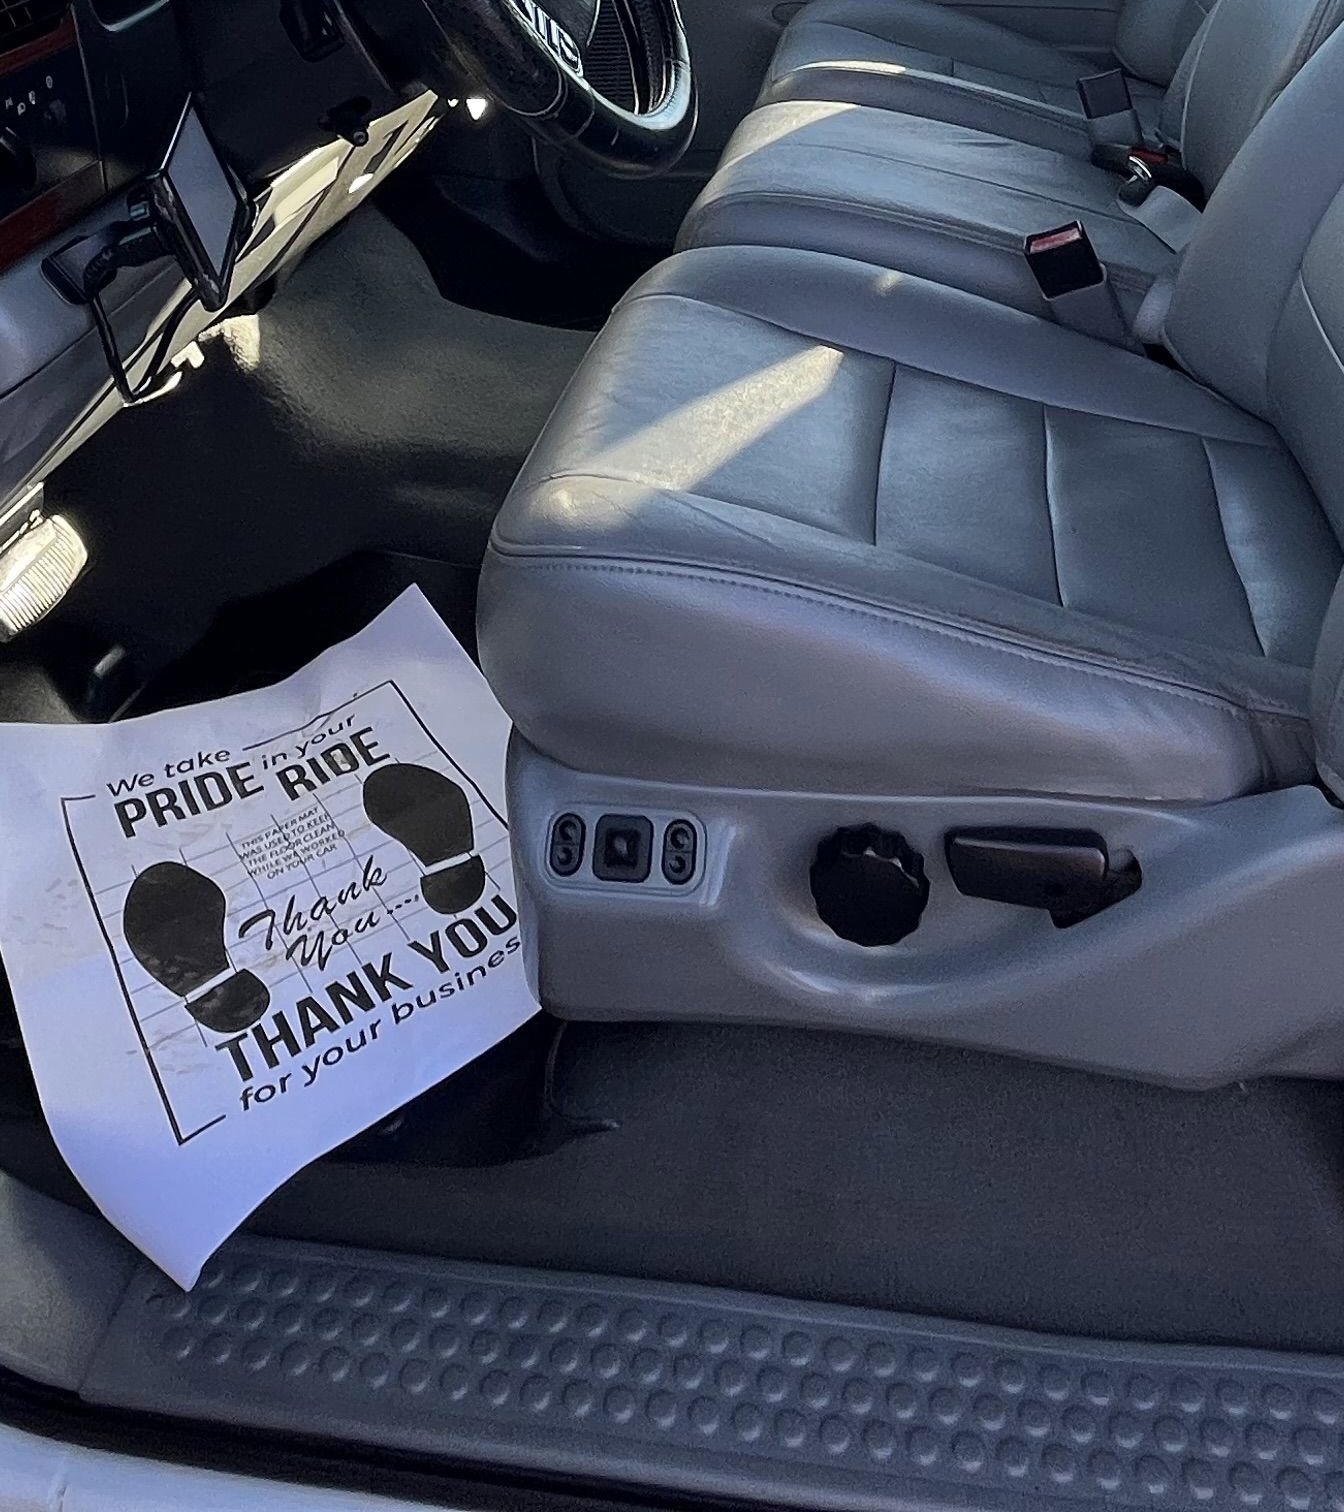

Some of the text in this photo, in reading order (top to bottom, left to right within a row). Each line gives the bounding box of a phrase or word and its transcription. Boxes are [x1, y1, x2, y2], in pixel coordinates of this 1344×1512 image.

[261, 714, 356, 770] in your
[107, 749, 231, 798] We take
[114, 726, 390, 839] PRIDE RIDE
[241, 807, 318, 849] THIS PAPER MAT
[241, 846, 262, 860] WAS
[264, 832, 290, 850] USED
[291, 825, 305, 837] TO
[248, 821, 337, 866] THE FLOOR CLEAN
[249, 858, 281, 875] WHILE
[300, 829, 345, 854] WORKED
[267, 843, 338, 879] ON YOUR CAR
[238, 855, 387, 950] Thank
[215, 894, 518, 1082] THANK YOU
[240, 936, 521, 1111] for your busines
